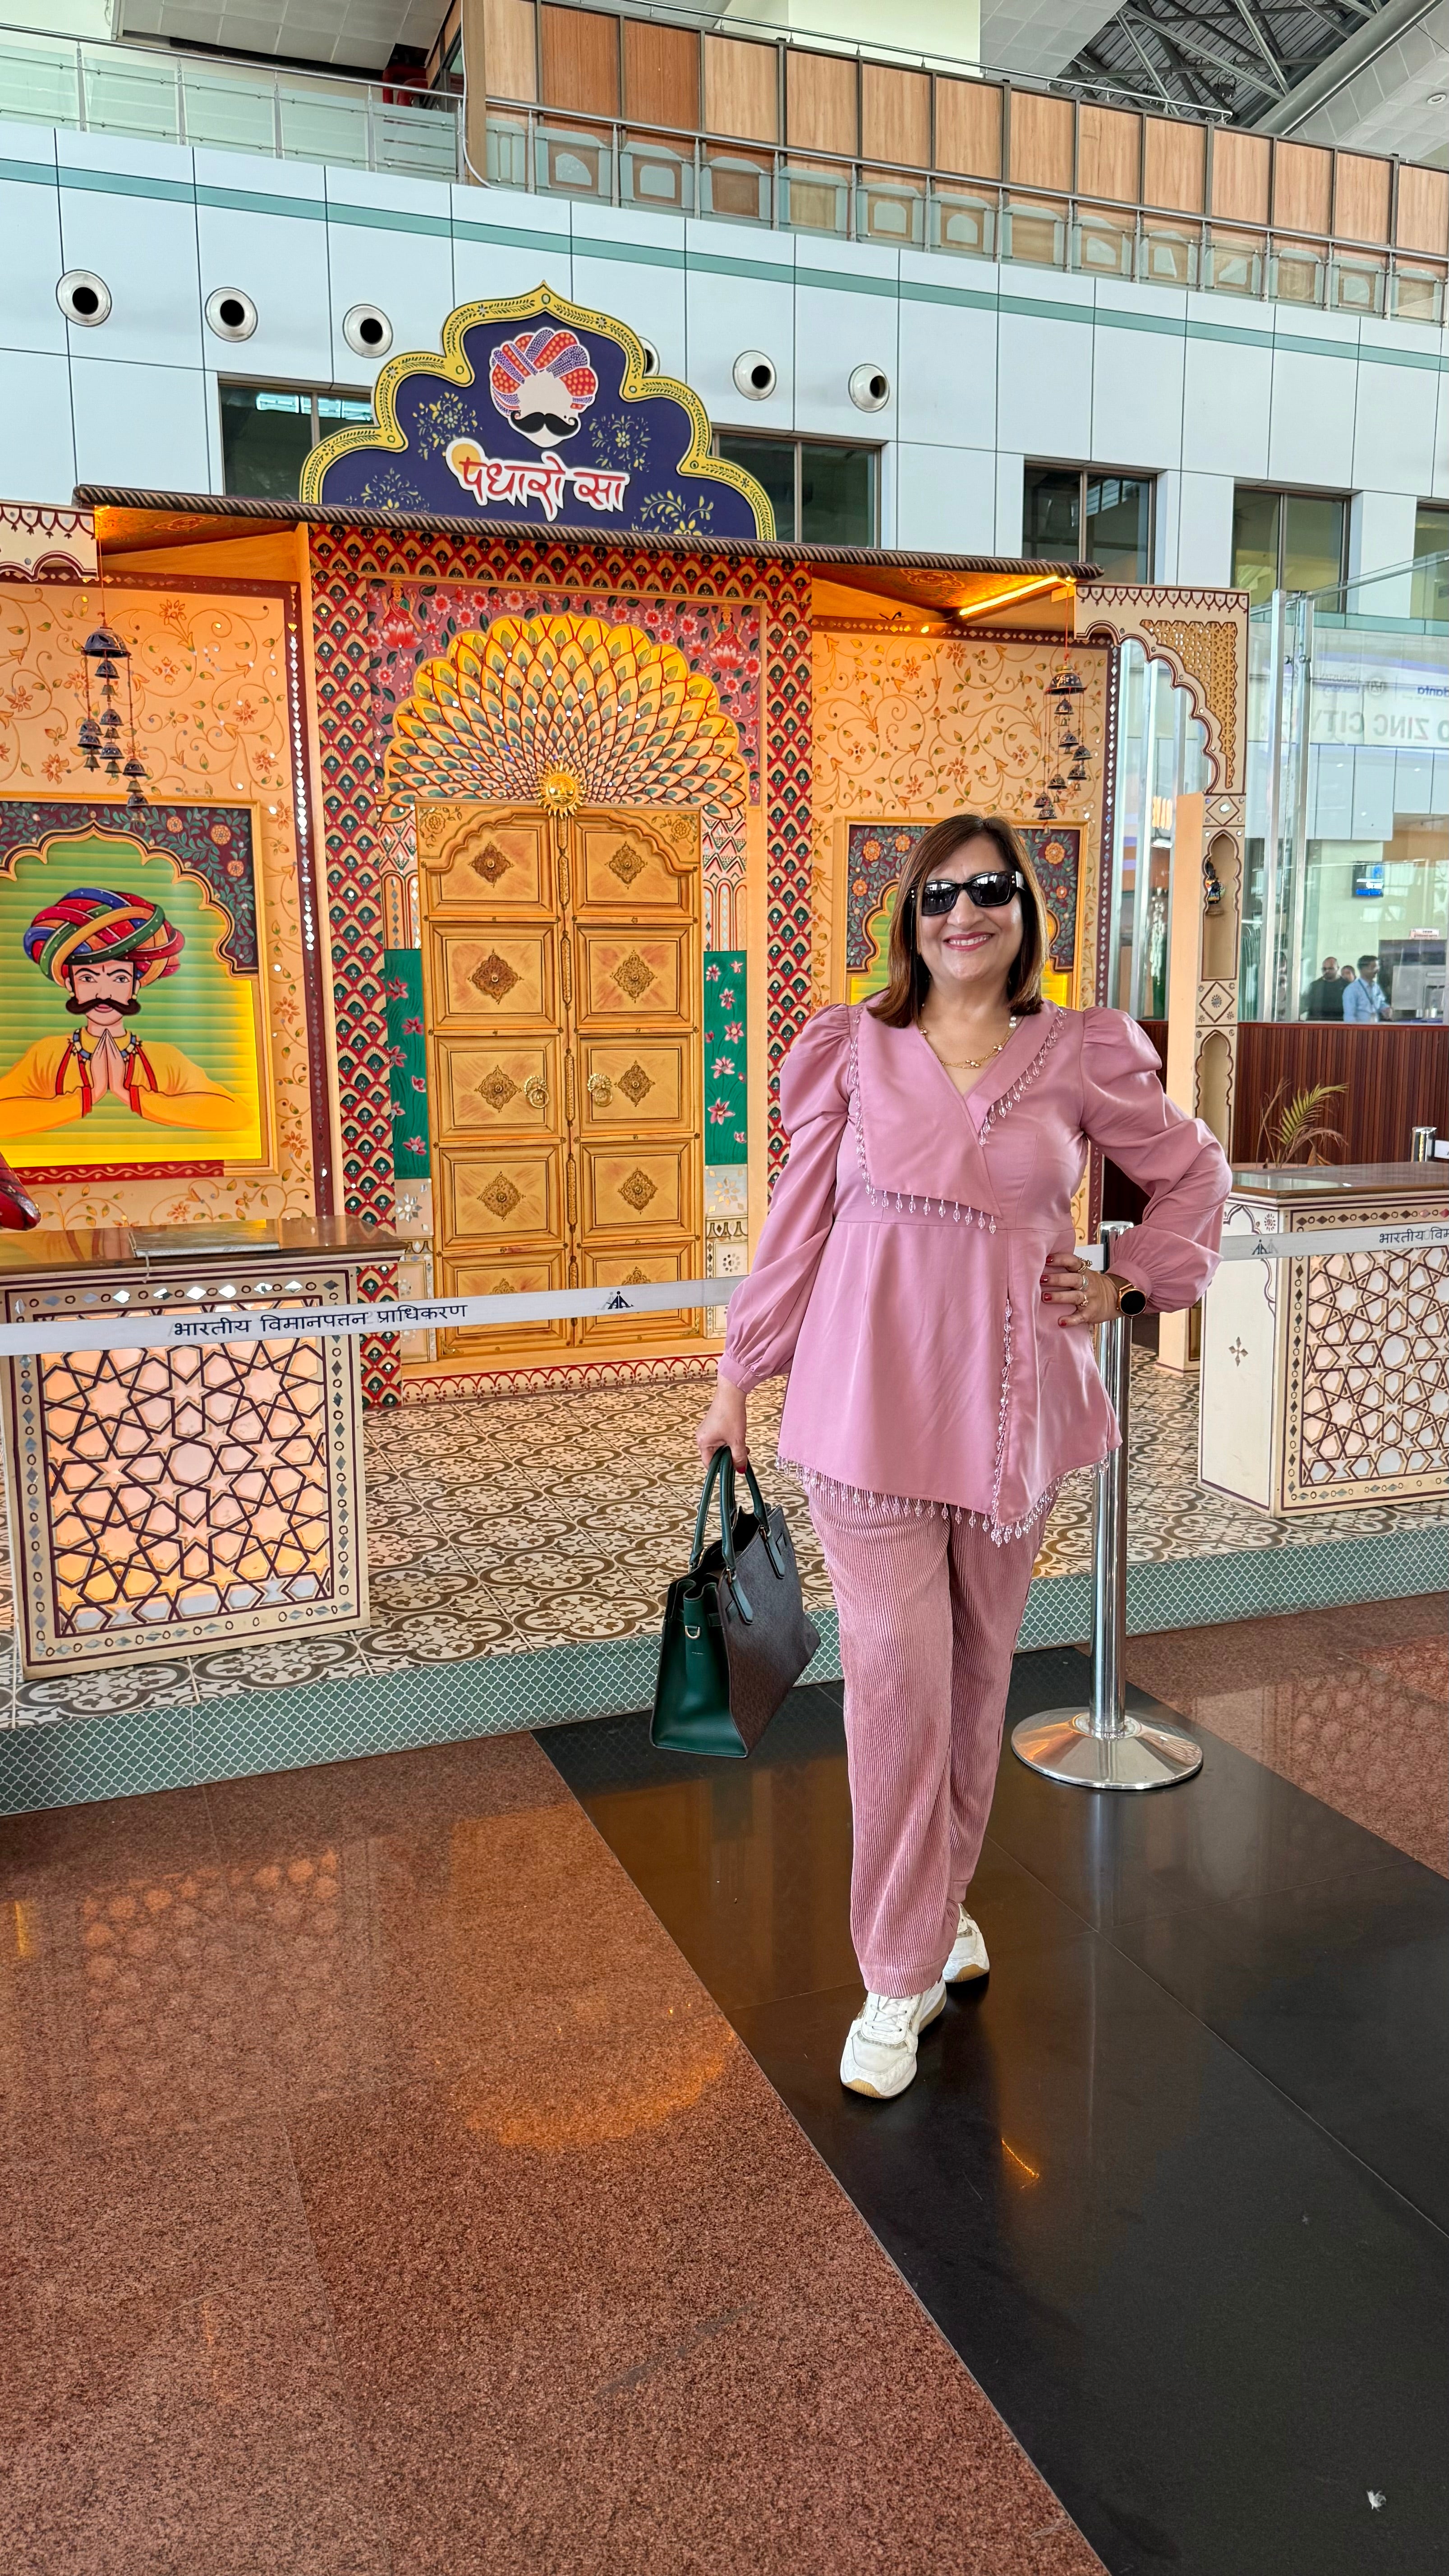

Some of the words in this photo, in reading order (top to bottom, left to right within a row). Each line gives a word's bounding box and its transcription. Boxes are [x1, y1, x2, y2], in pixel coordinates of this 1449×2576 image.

[573, 471, 626, 506] सा
[1379, 1228, 1426, 1243] भारतीय
[174, 1317, 252, 1336] भारतीय
[260, 1311, 368, 1332] विमानपत्तन
[377, 1305, 468, 1323] प्राधिकरण
